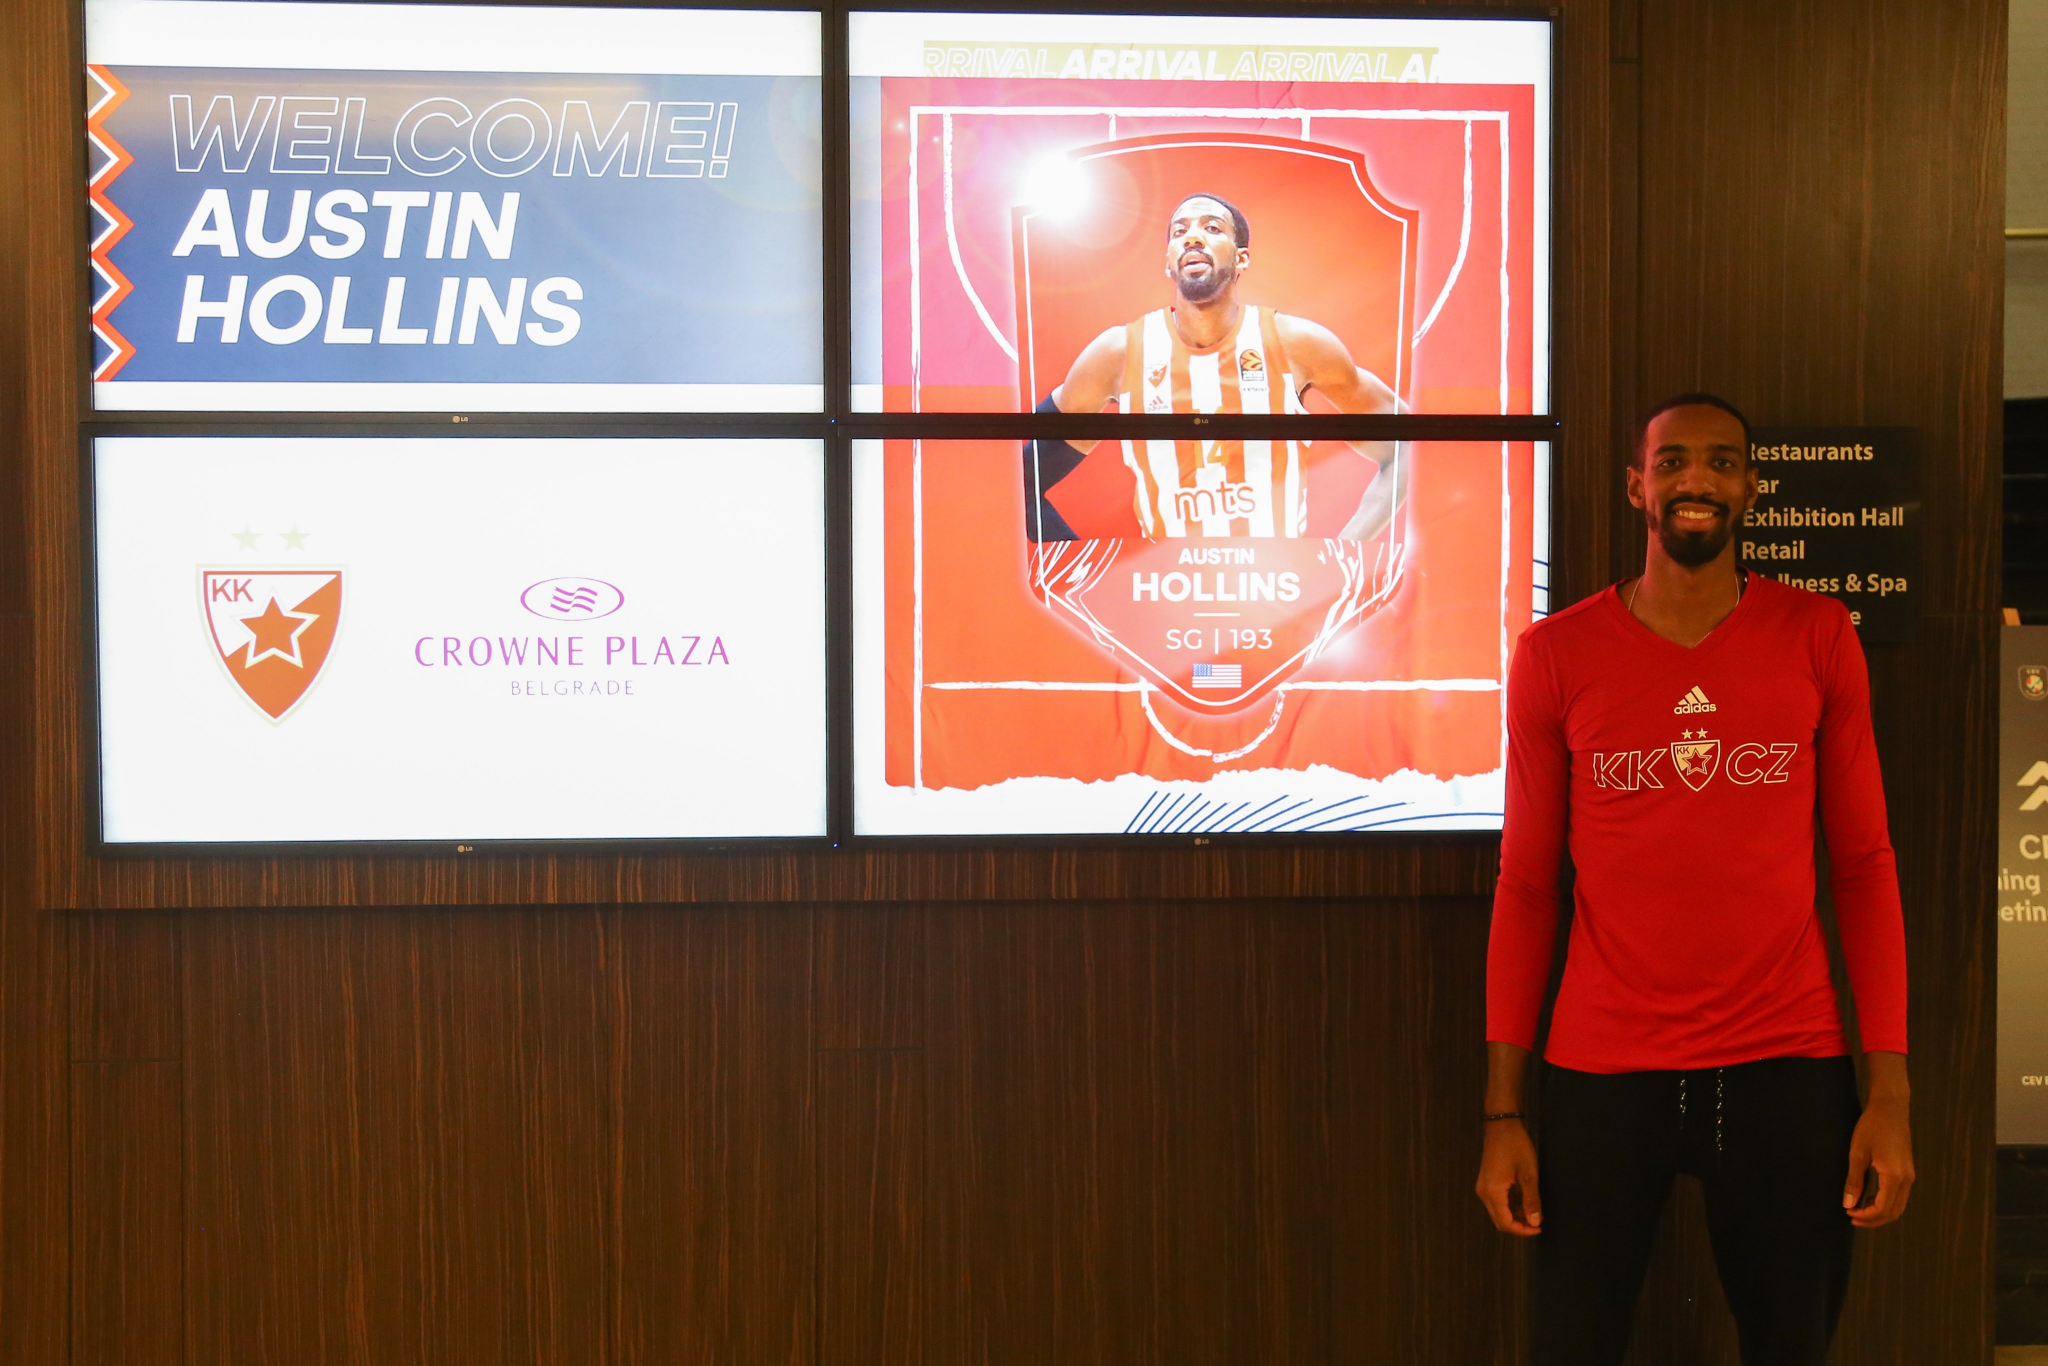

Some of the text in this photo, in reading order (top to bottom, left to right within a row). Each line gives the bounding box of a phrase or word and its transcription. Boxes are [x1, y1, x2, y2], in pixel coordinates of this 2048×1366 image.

[1059, 49, 1227, 80] ARRIVAL
[1230, 51, 1396, 83] ARRIVAL
[169, 94, 738, 179] WELCOME!
[172, 188, 521, 260] AUSTIN
[176, 274, 583, 346] HOLLINS
[1757, 479, 1780, 494] ar
[1174, 481, 1256, 519] mts
[1743, 506, 1904, 527] Exhibition Hall
[1178, 548, 1255, 565] AUSTIN
[1742, 540, 1805, 560] Retail
[212, 578, 254, 602] KK
[1132, 571, 1301, 602] HOLLINS
[1760, 573, 1907, 597] llness & Spa
[1165, 628, 1202, 650] SG
[1228, 628, 1273, 650] 193
[414, 636, 730, 667] CROWNE PLAZA
[511, 680, 634, 696] BELGRADE
[1673, 702, 1717, 715] adidas
[1676, 746, 1690, 755] KK
[1593, 742, 1798, 791] KK CZ
[1998, 899, 2048, 922] etin
[2021, 1075, 2043, 1086] CEV
